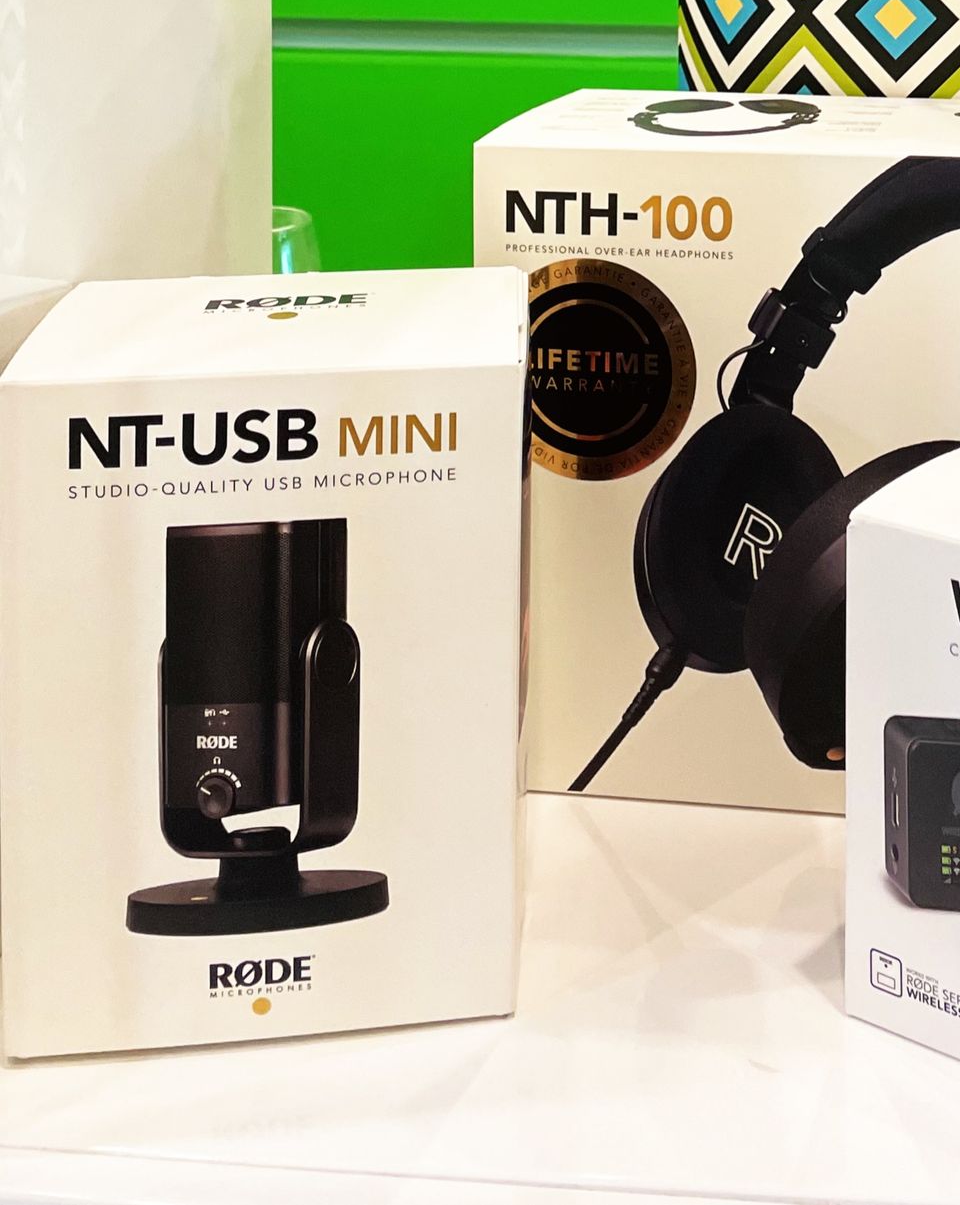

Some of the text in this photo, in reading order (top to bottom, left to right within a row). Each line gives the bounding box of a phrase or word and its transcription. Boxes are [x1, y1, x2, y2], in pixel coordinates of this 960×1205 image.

[505, 189, 733, 242] NTH-100
[505, 243, 734, 261] PROFESSIONAL OVER-EAR HEADPHONES
[205, 293, 369, 310] RØDE
[530, 347, 659, 376] IFETIME
[68, 408, 458, 470] NT-USB MINI
[68, 467, 458, 500] STUDIO-QUALITY USB MICROPHONE
[723, 502, 783, 580] R
[196, 735, 238, 749] RØDE
[208, 955, 312, 989] RØDE
[906, 975, 938, 996] RØDE
[209, 983, 312, 998] MICROPHONES
